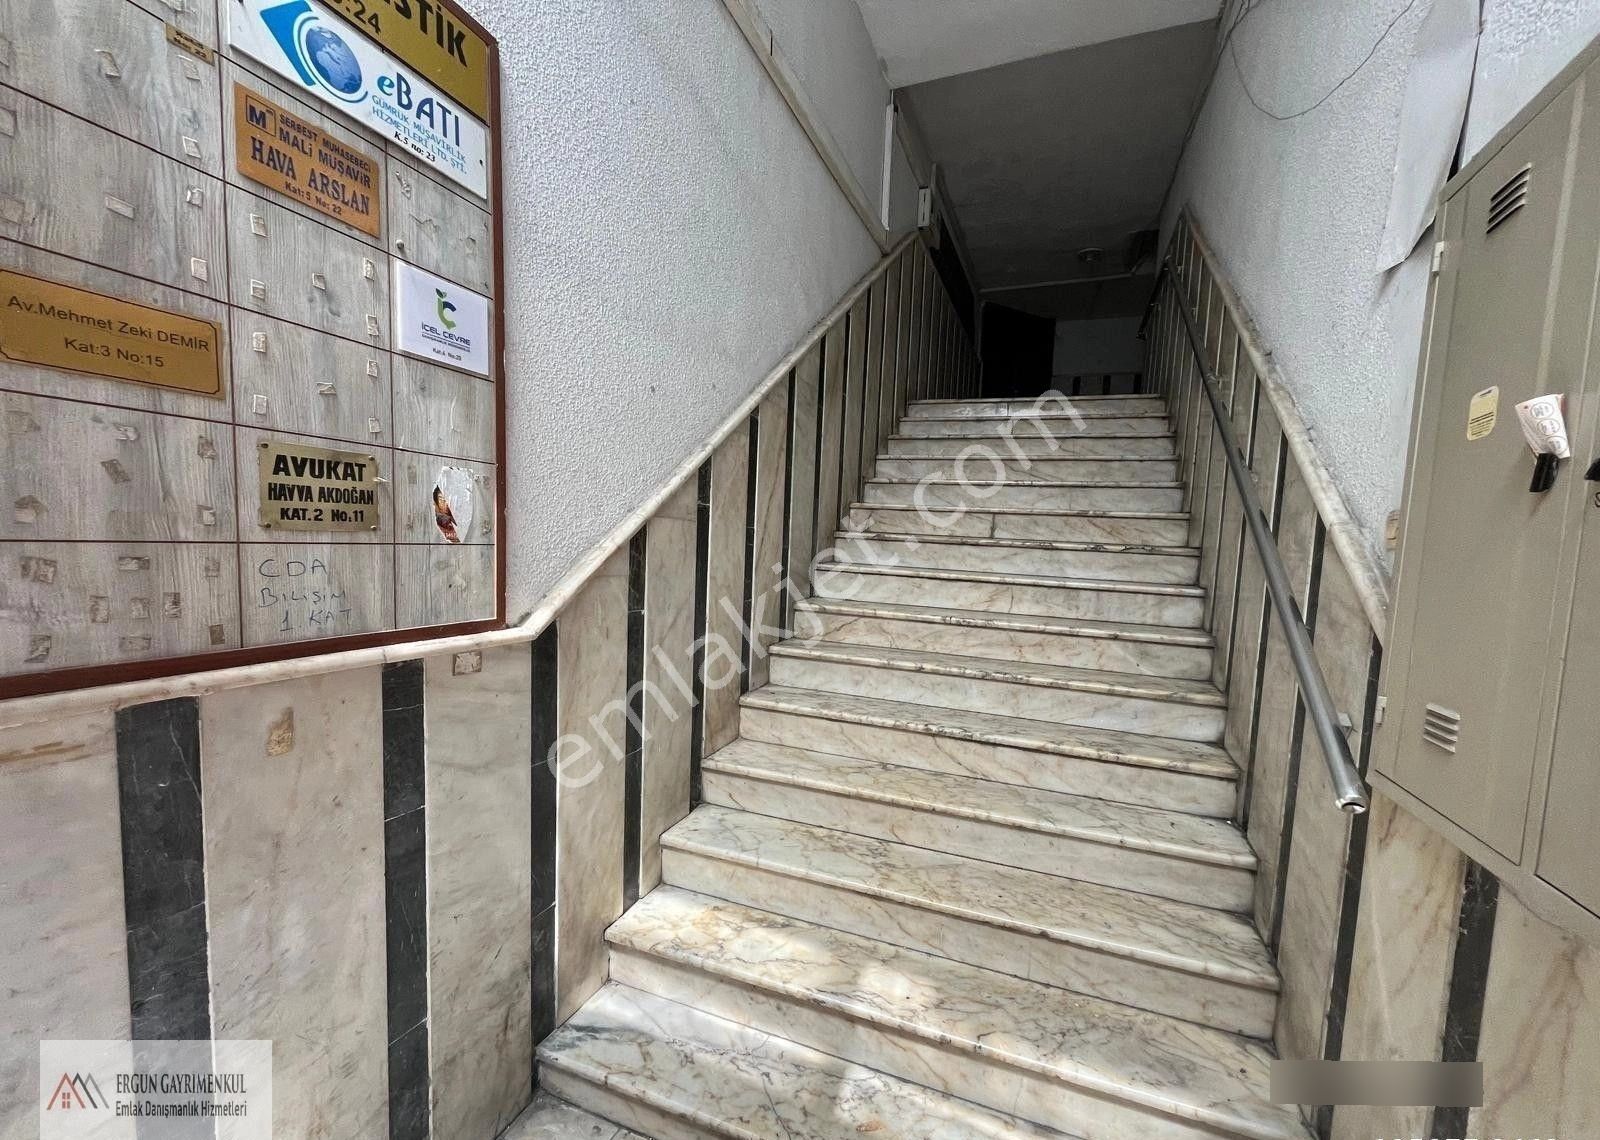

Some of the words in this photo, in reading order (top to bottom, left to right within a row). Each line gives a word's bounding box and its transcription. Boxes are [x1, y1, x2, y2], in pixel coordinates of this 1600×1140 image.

[377, 72, 460, 147] eBATI
[279, 113, 318, 142] SERBEST
[250, 136, 296, 180] HAVA
[308, 168, 370, 215] ARSLAN
[118, 320, 151, 338] Zeki
[64, 337, 110, 357] Kat:3
[117, 348, 164, 368] No:15
[272, 454, 367, 482] AVUKAT
[267, 482, 314, 503] HAVVA
[318, 486, 374, 505] AKDOĞAN
[259, 559, 328, 578] CDA
[309, 608, 352, 628] KAT
